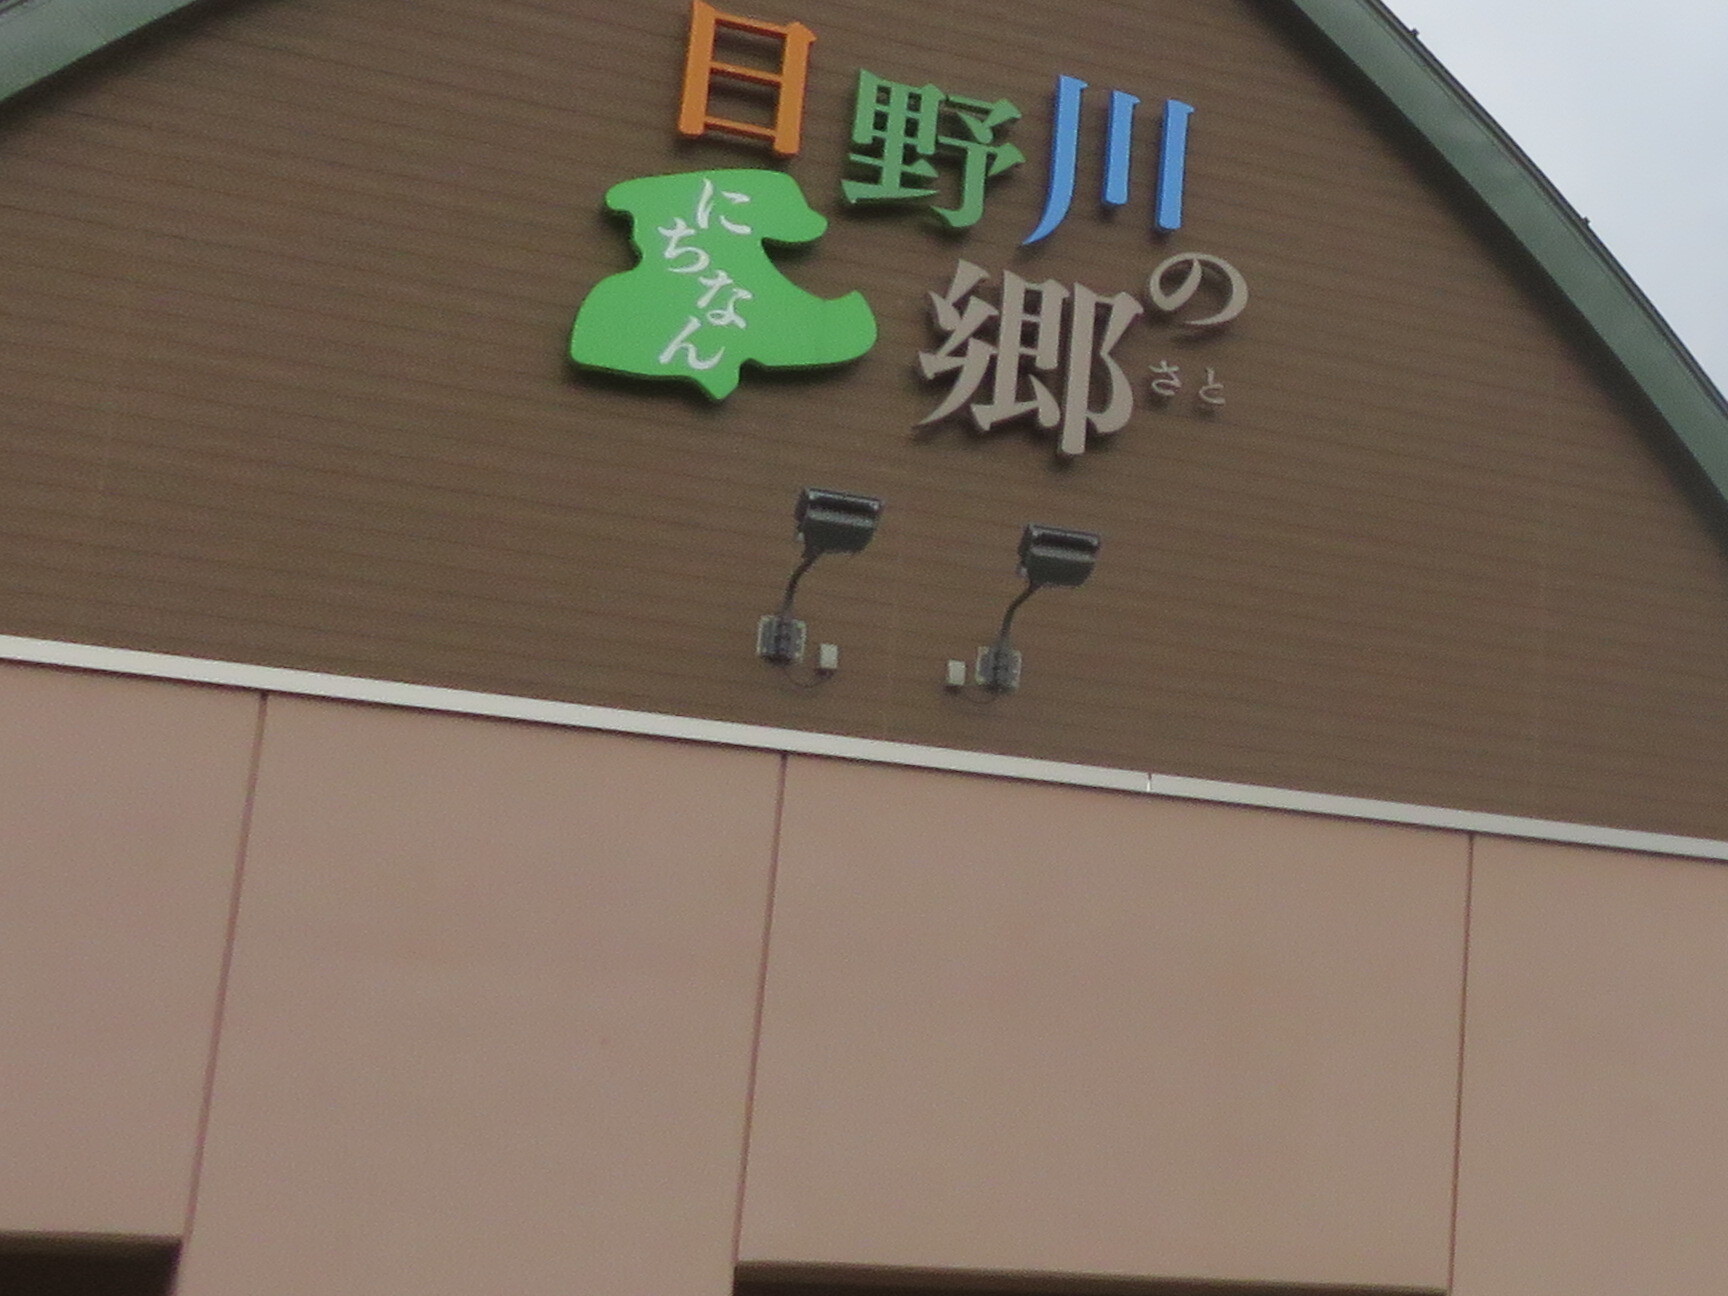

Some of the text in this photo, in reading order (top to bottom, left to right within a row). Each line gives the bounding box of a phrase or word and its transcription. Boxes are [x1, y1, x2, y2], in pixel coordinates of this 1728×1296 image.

[657, 179, 752, 370] にちなん
[1150, 360, 1225, 405] さと
